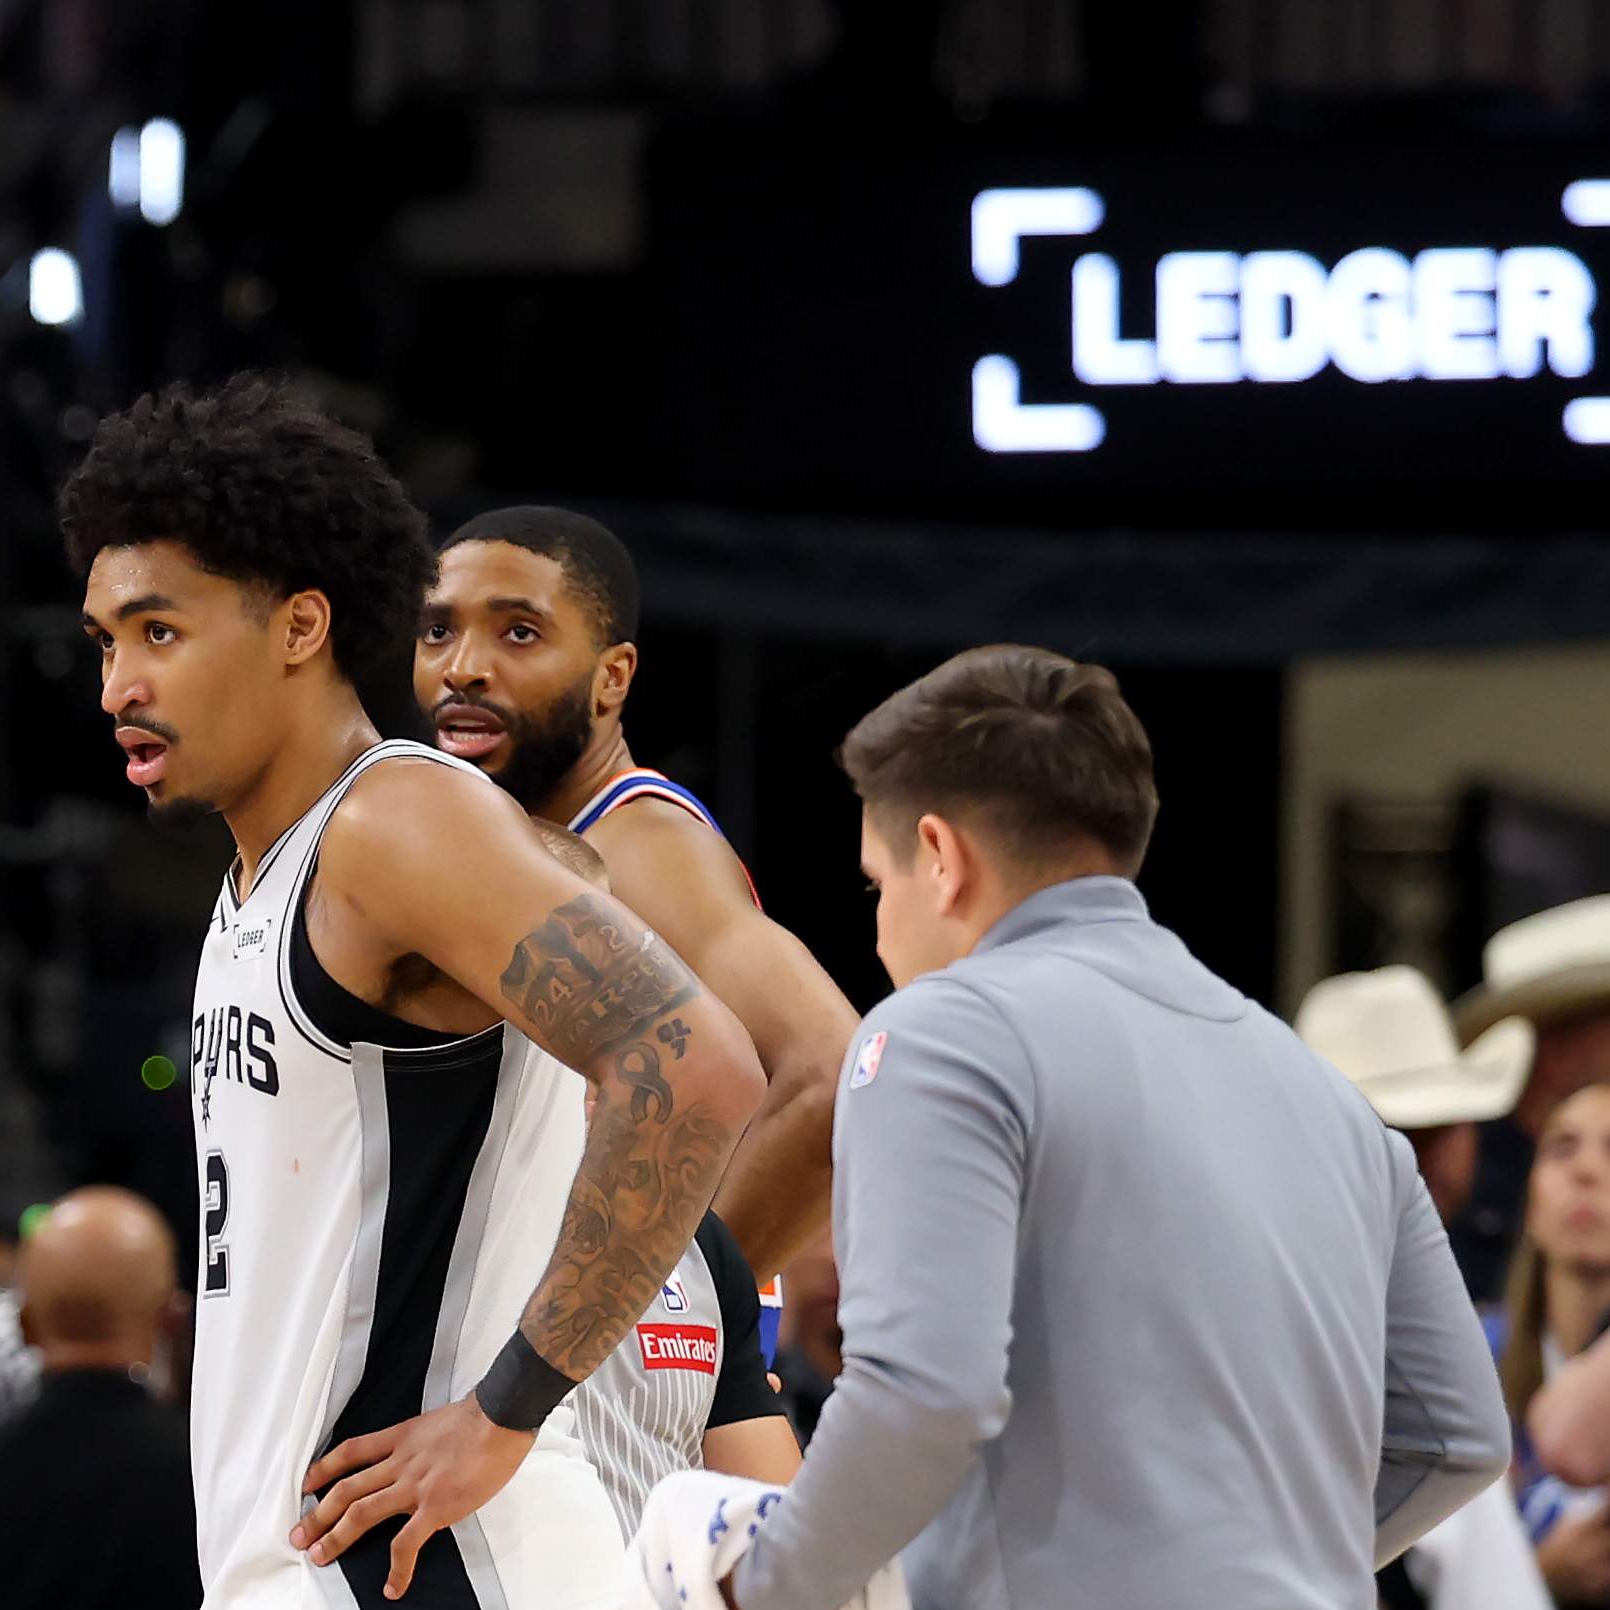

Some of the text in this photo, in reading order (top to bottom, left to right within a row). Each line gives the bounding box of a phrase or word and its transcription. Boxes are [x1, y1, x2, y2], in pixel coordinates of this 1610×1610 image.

[1072, 247, 1596, 385] LEDGER
[237, 929, 264, 948] LEDGER
[193, 1005, 280, 1112] PURS
[201, 1148, 231, 1299] 2
[642, 1331, 716, 1364] Emirates
